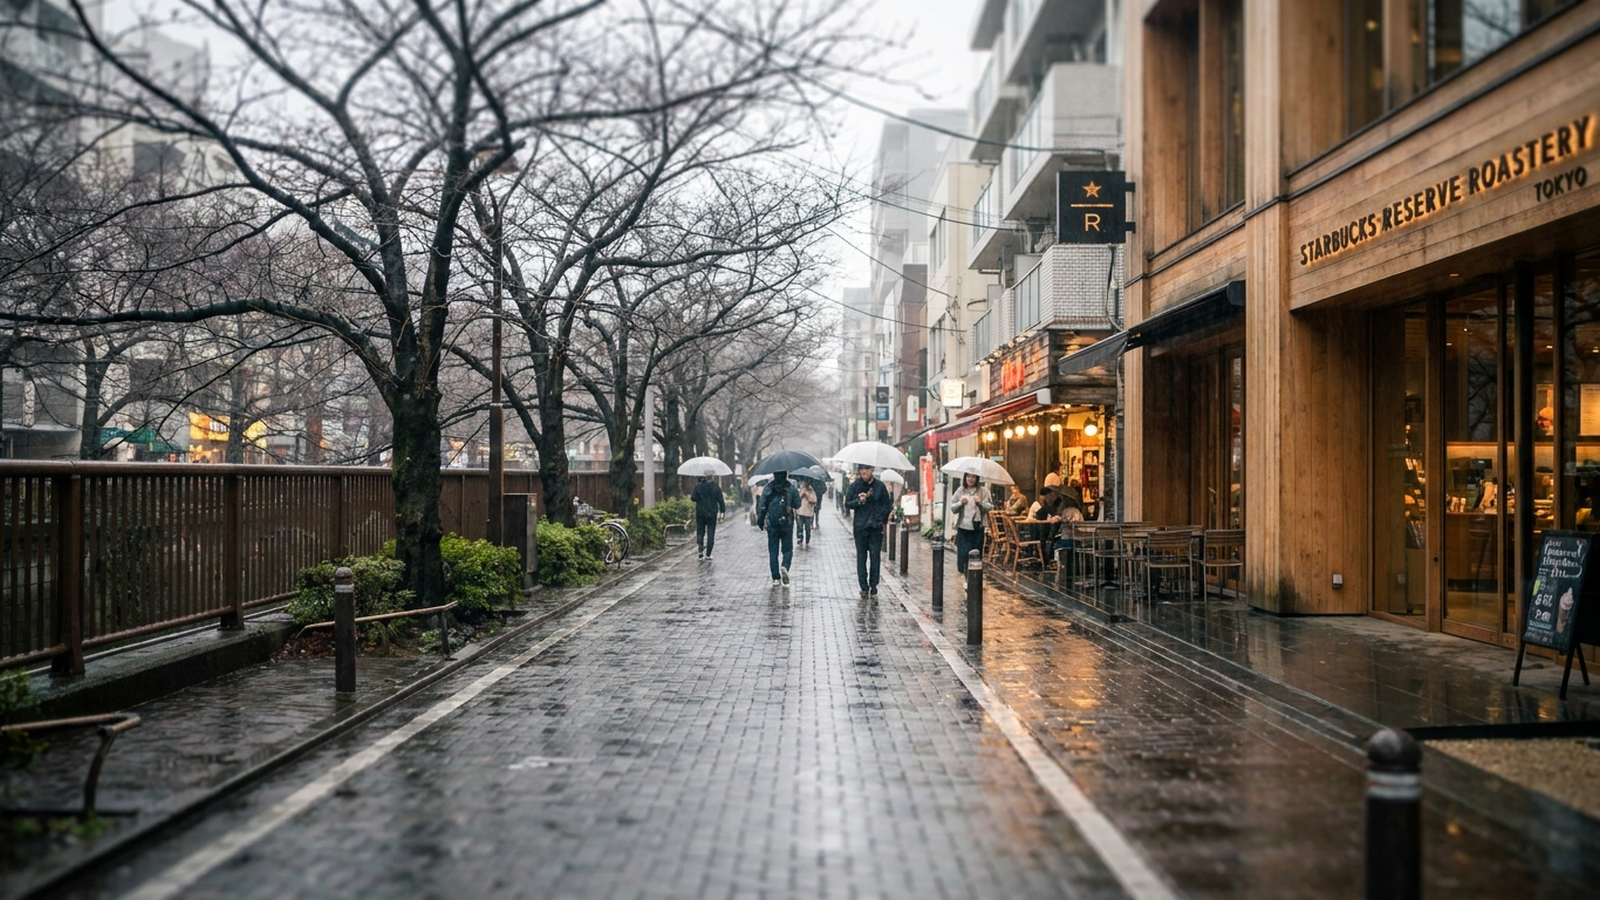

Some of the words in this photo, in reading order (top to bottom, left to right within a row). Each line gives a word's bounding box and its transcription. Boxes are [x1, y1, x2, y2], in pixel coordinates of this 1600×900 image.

[1300, 213, 1377, 265] STARBUCKS
[1382, 175, 1462, 231] RESERVE
[1468, 116, 1591, 195] ROASTERY
[1534, 166, 1587, 202] TOKYO
[1085, 213, 1101, 232] R
